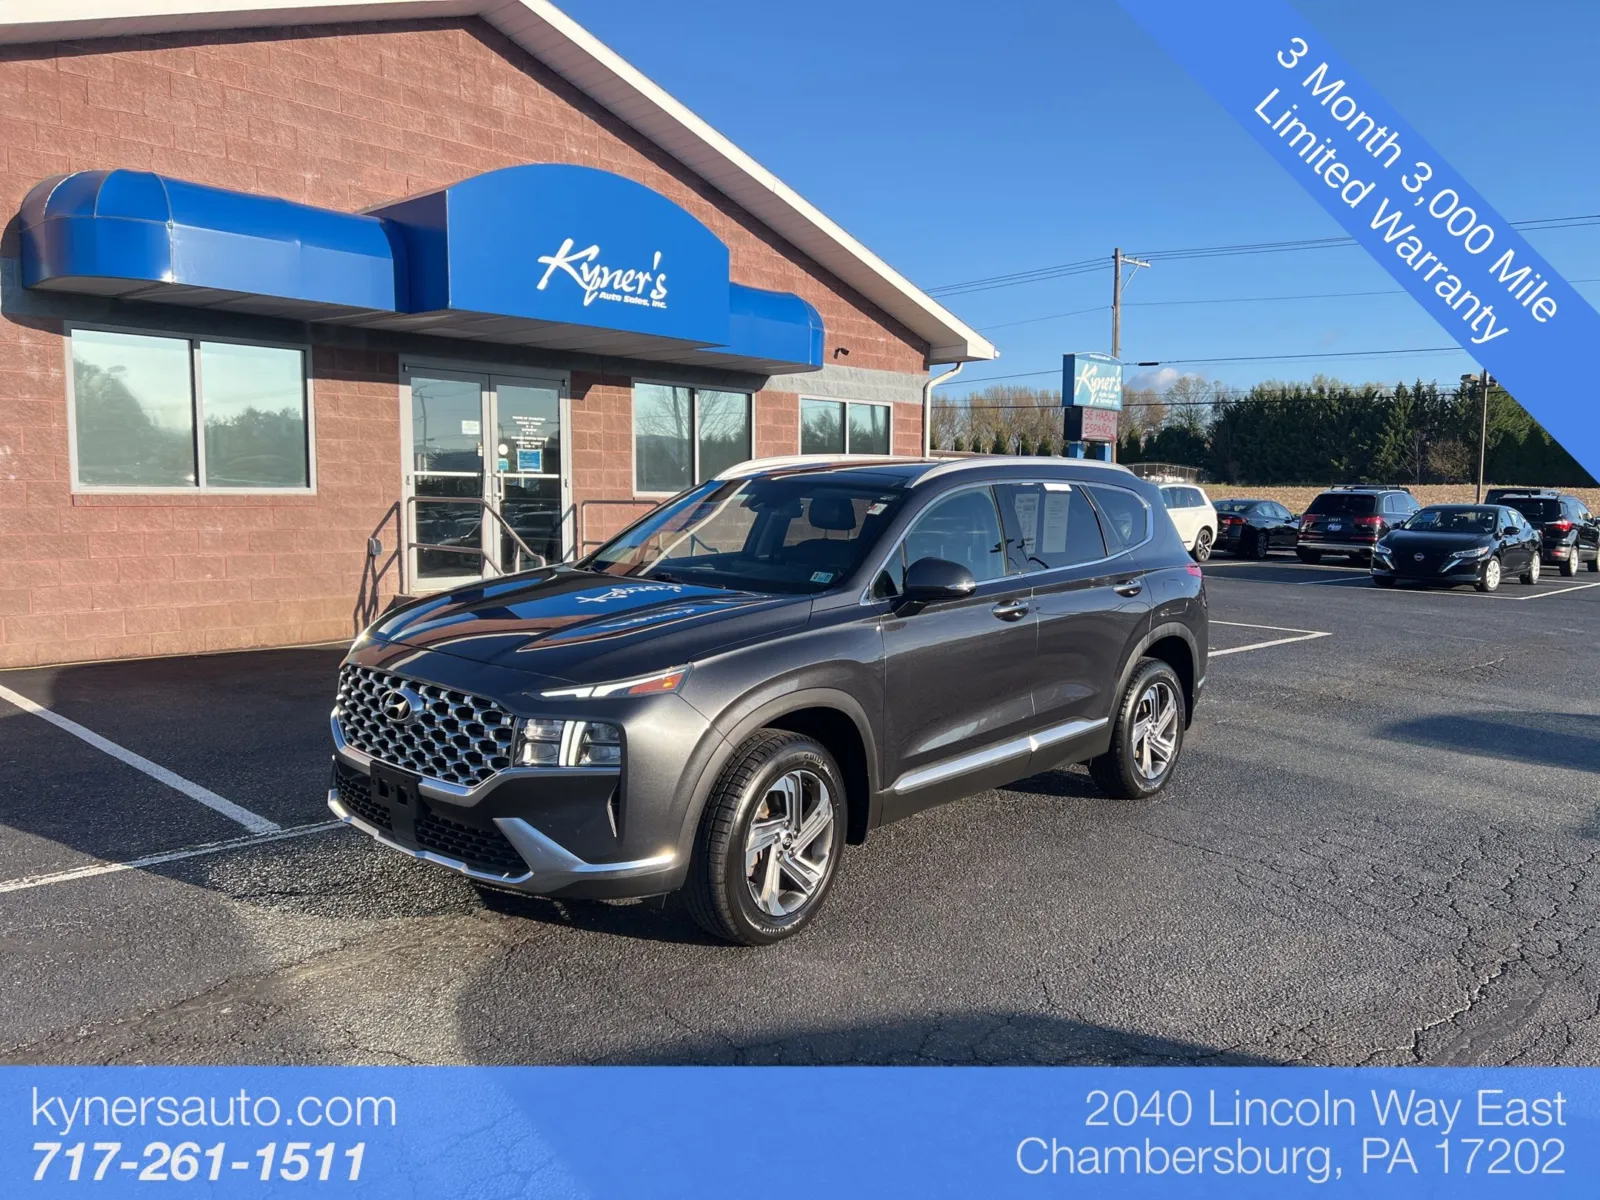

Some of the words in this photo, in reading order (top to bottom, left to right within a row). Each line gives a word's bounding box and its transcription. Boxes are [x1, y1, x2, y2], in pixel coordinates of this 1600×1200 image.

[536, 237, 667, 306] Kyner's
[599, 291, 622, 302] Auto
[623, 295, 650, 307] Sales,
[1075, 363, 1121, 405] Kyner's
[1084, 409, 1094, 420] SE
